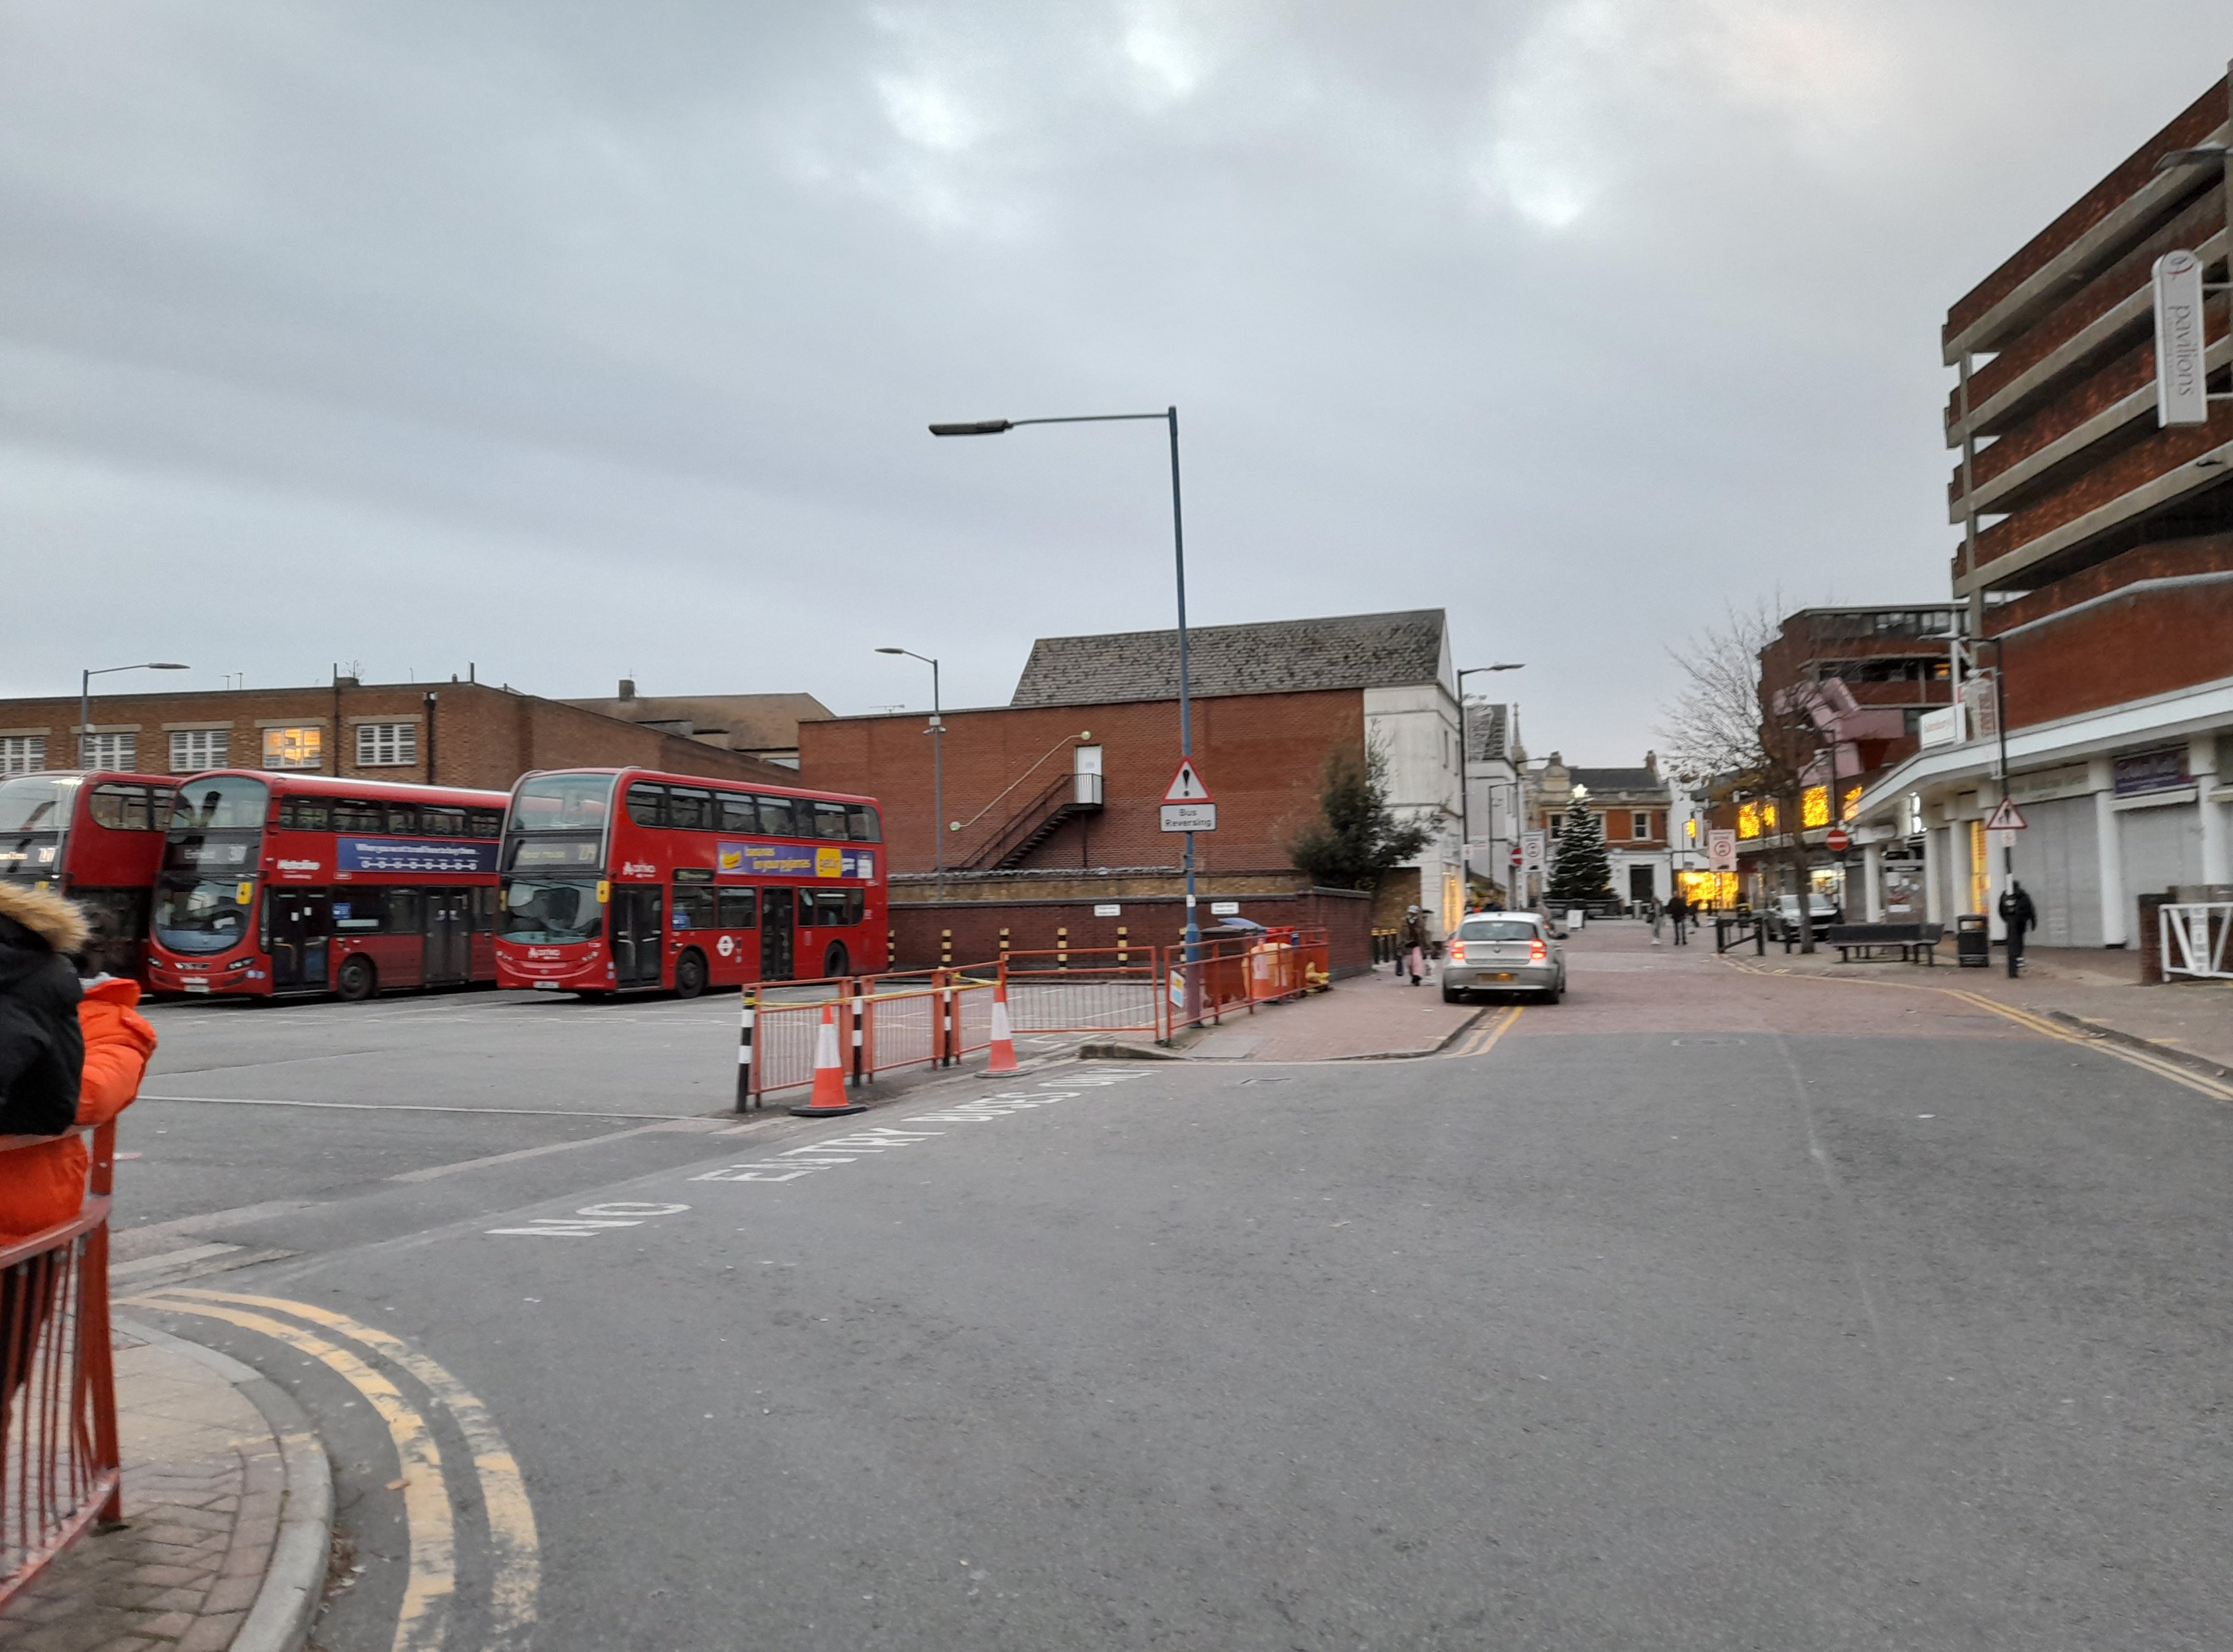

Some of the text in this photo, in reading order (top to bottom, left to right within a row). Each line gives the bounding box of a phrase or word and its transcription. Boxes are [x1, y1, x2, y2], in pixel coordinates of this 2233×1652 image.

[2168, 304, 2198, 396] pavilions
[1164, 818, 1212, 828] Reversing
[1179, 808, 1198, 817] Bus
[484, 1068, 1164, 1237] NO ENTRY BUSES ONLY
